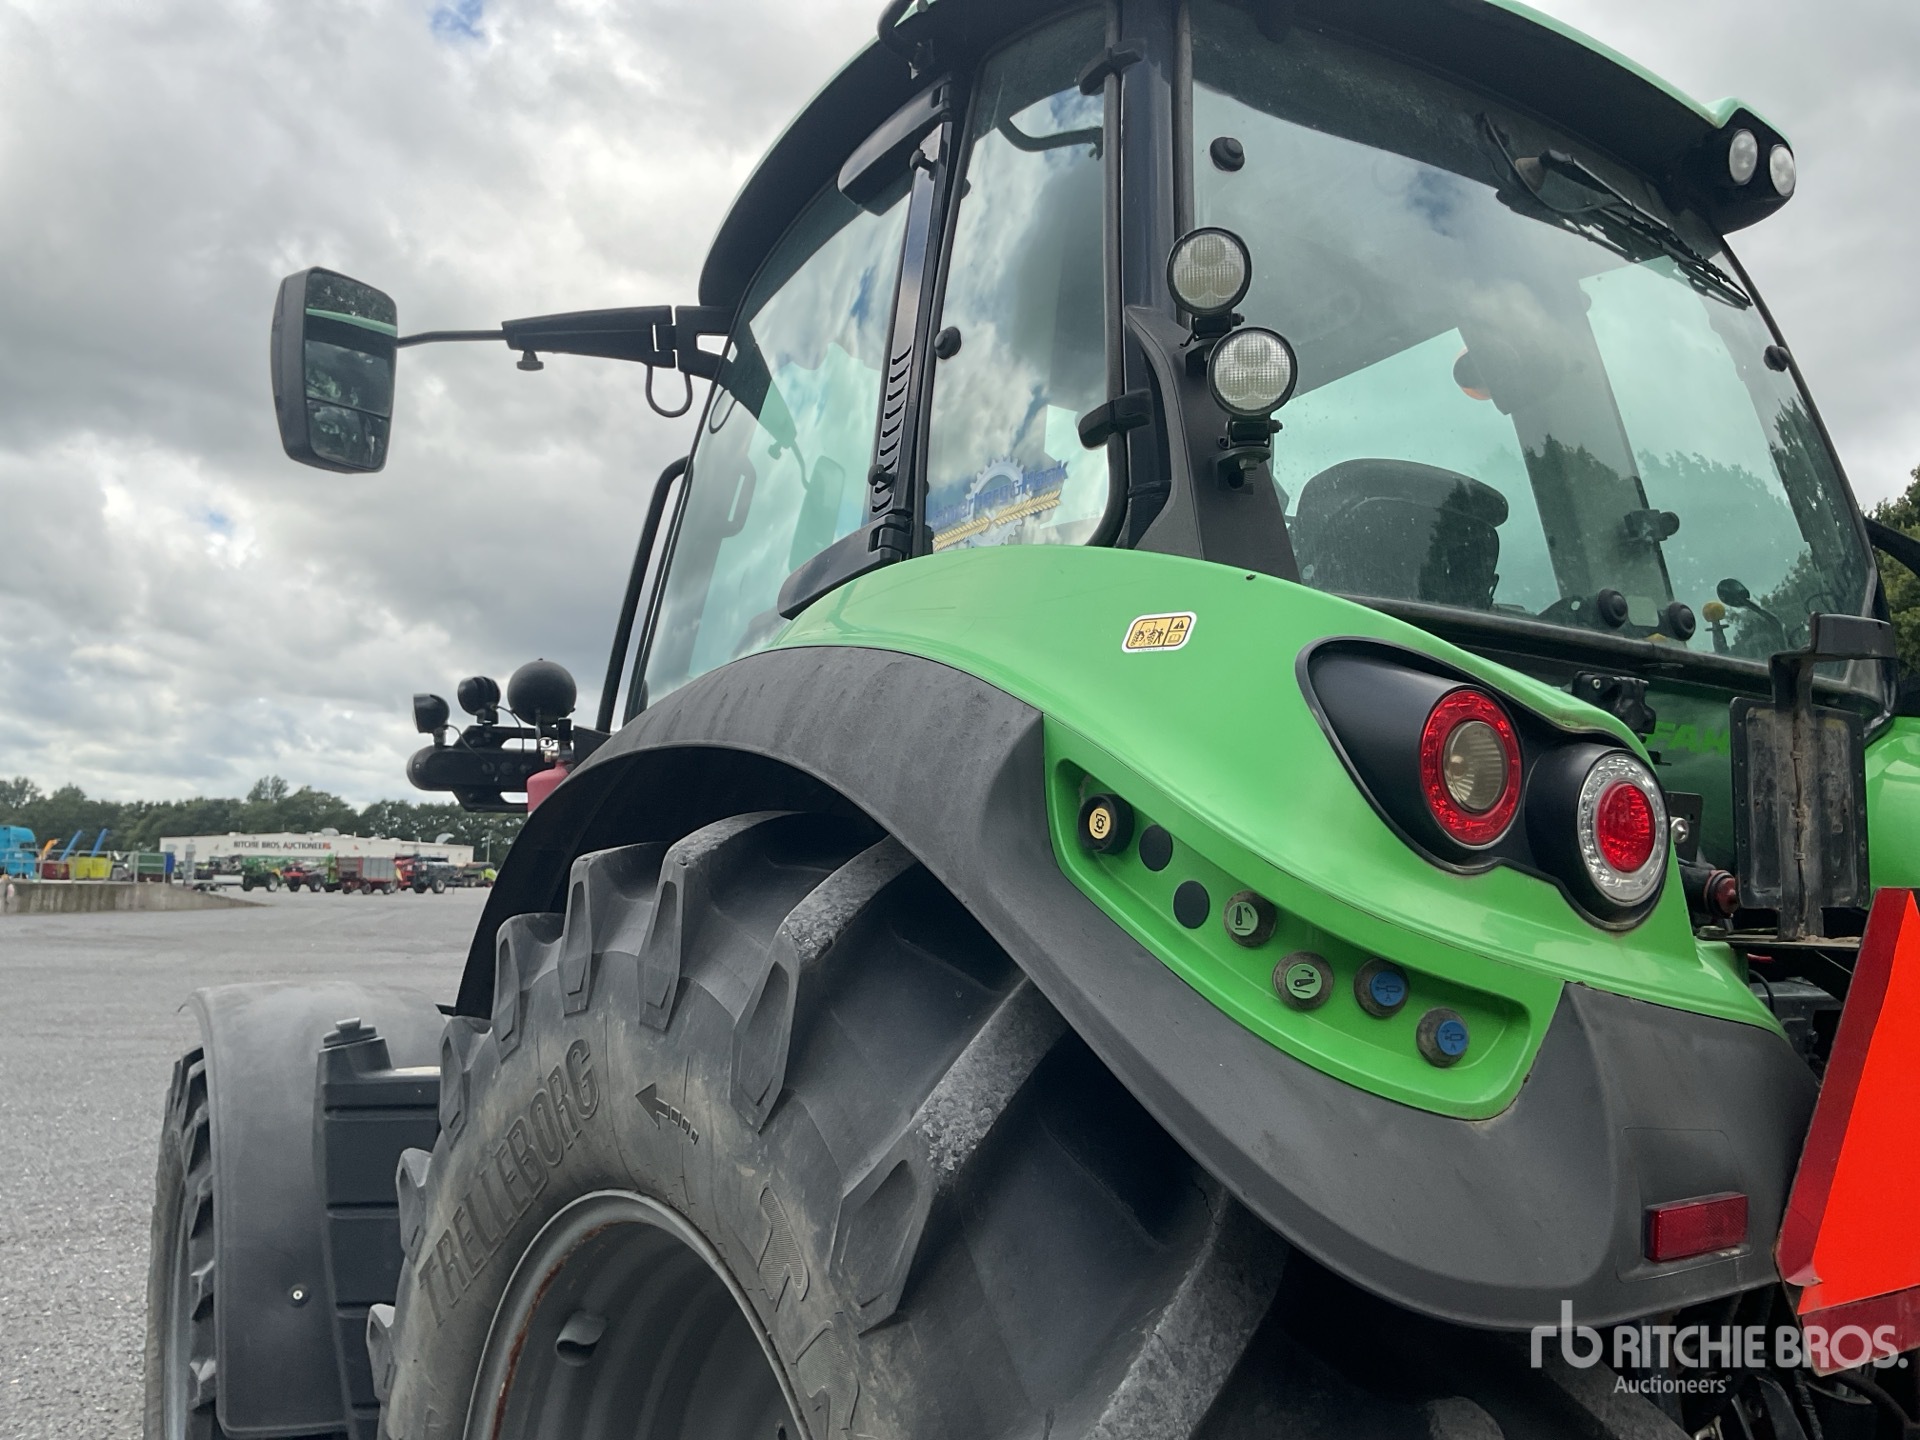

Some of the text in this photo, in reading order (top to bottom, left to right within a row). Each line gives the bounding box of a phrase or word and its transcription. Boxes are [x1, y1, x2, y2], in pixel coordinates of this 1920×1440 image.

[1645, 720, 1731, 757] FAH
[233, 841, 259, 849] RITCHIE
[283, 842, 331, 850] AUCTIONEERS
[416, 1037, 600, 1328] TRELLEBORG
